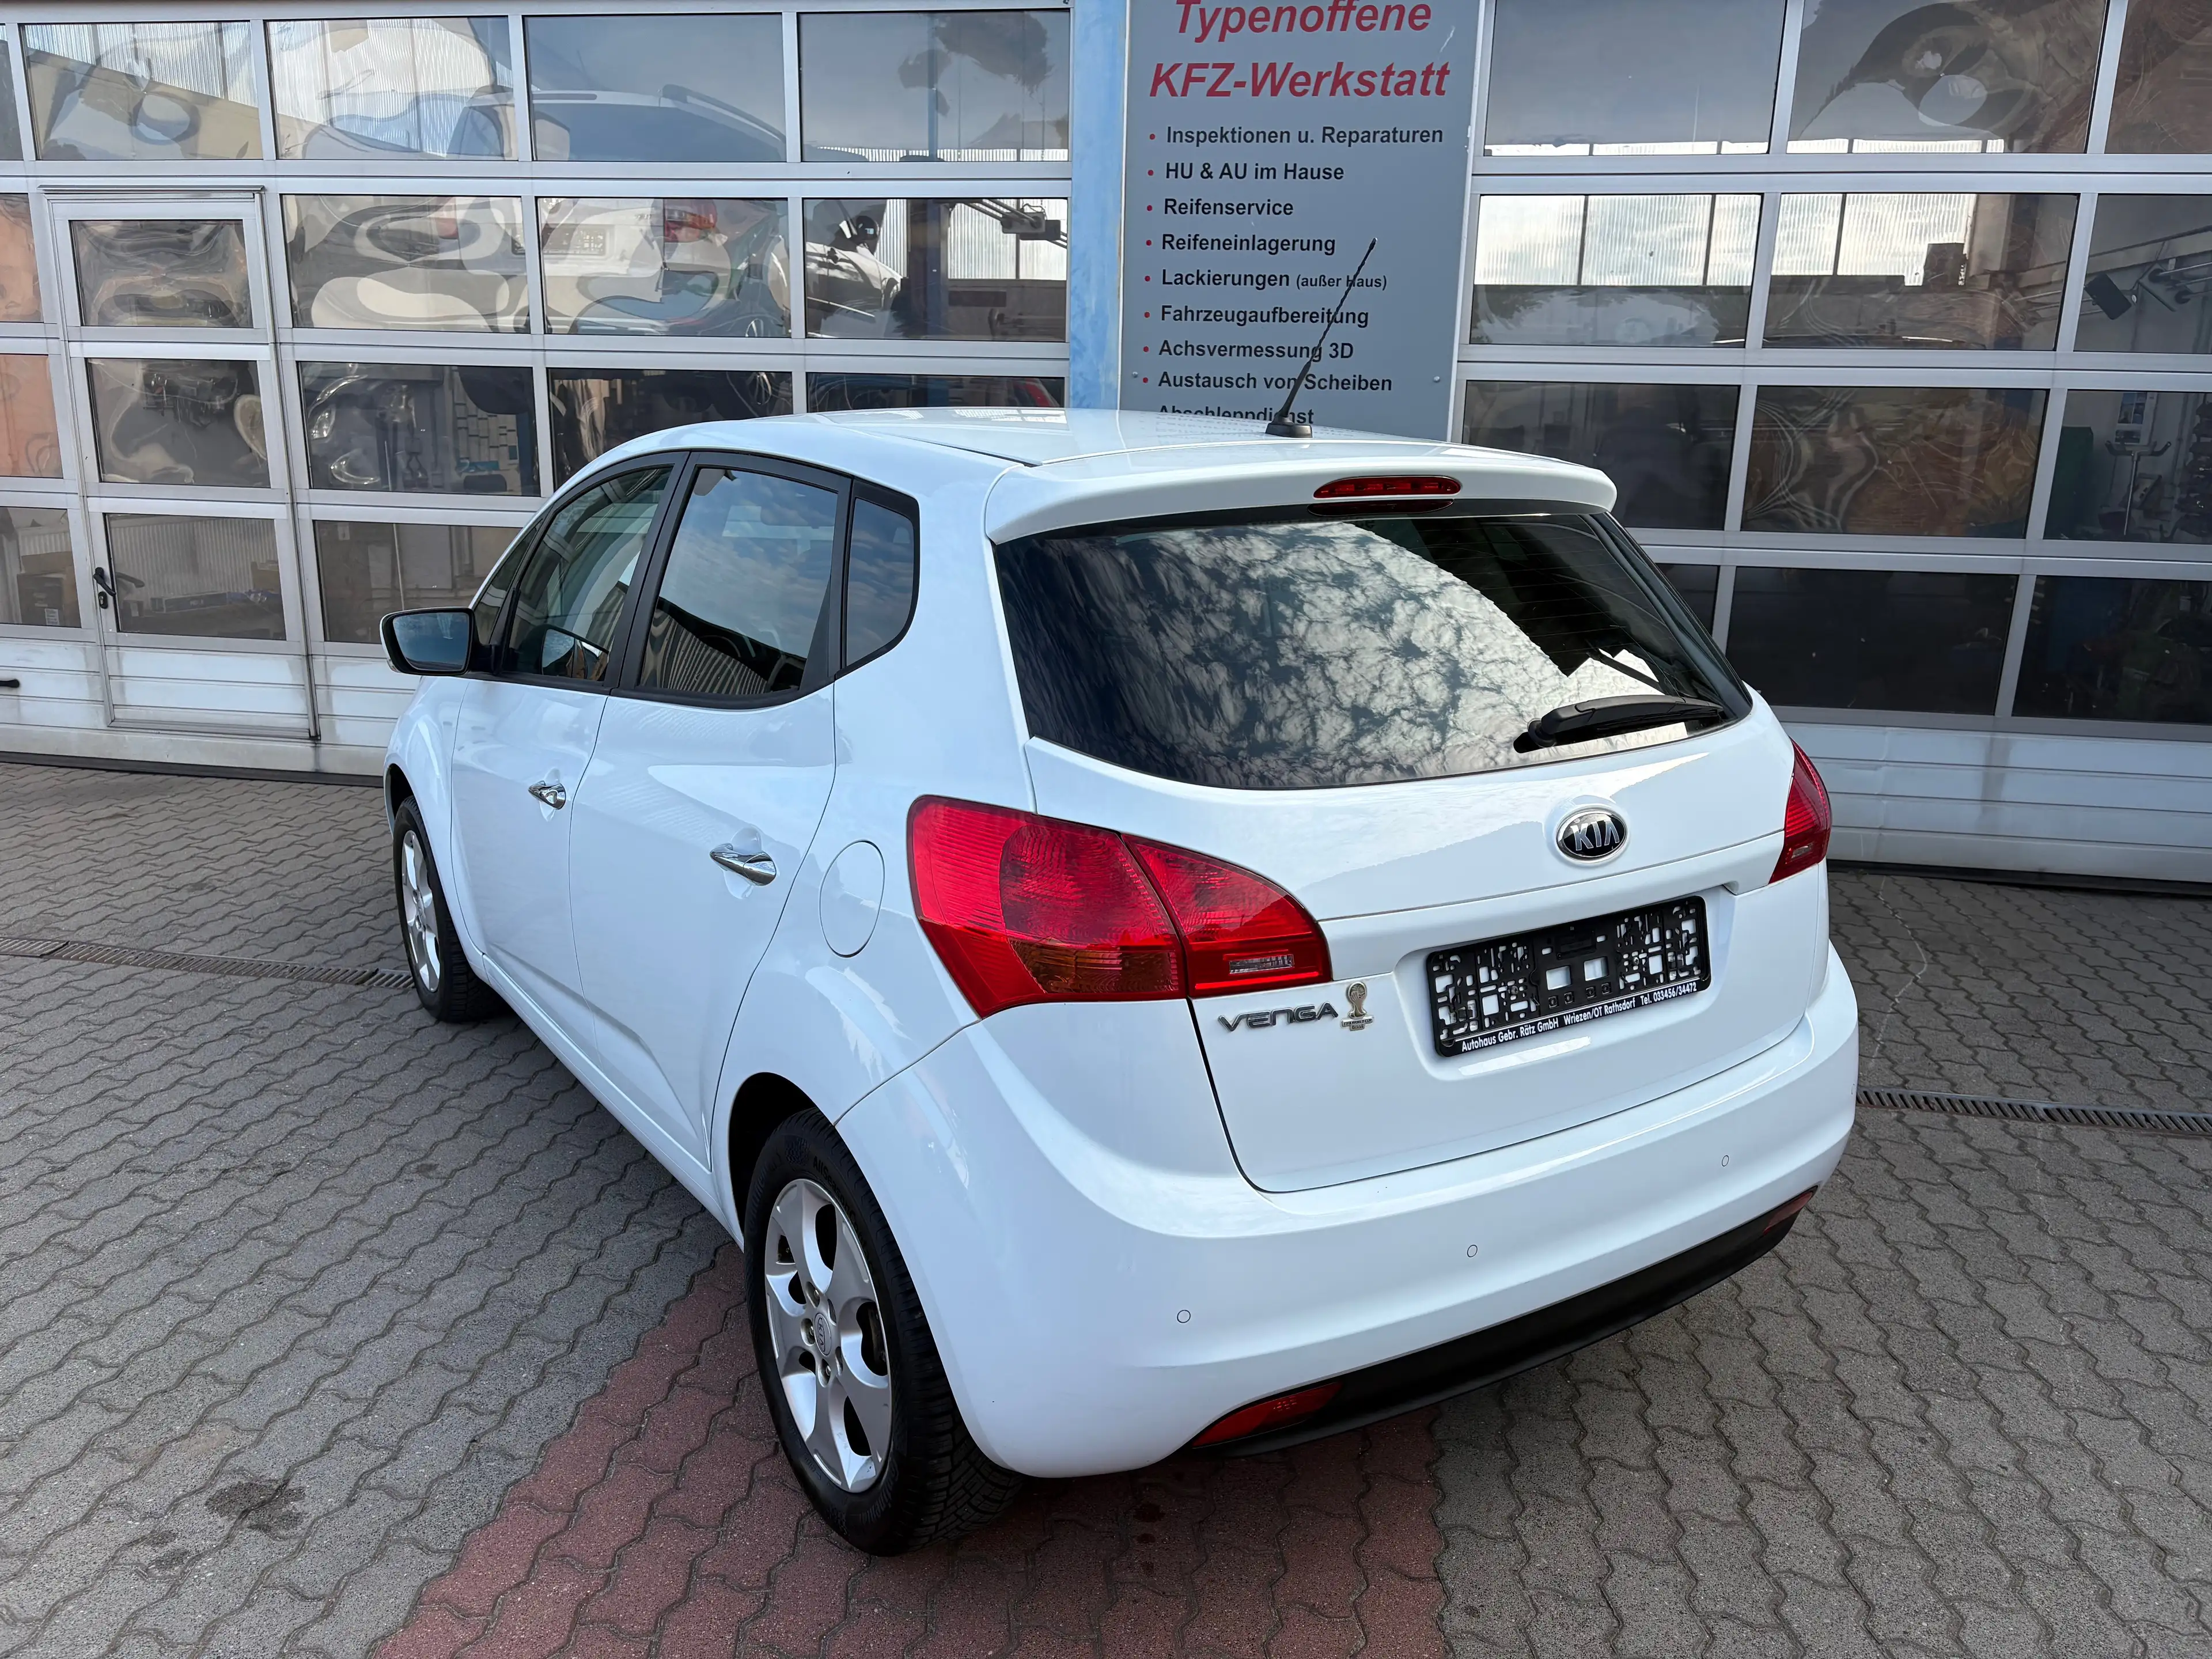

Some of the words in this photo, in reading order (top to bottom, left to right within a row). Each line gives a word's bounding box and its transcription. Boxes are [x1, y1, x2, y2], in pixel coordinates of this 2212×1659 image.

[1176, 0, 1431, 43] Typenoffene
[1150, 62, 1450, 97] KFZ-Werkstatt
[1166, 126, 1291, 148] Inspektionen
[1297, 130, 1315, 144] u.
[1321, 126, 1444, 147] Reparaturen
[1165, 161, 1194, 180] HU
[1199, 162, 1214, 180] &
[1218, 162, 1248, 180] AU
[1254, 162, 1277, 180] im
[1283, 162, 1345, 181] Hause
[1164, 198, 1294, 216] Reifenservice
[1161, 233, 1336, 256] Reifeneinlagerung
[1161, 268, 1290, 290] Lackierungen
[1296, 274, 1342, 290] (außer
[1346, 275, 1387, 291] Haus)
[1161, 304, 1369, 328] Fahrzeugaufbereitung
[1158, 339, 1323, 362] Achsvermessung
[1328, 342, 1354, 359] 3D
[1157, 371, 1257, 389] Austausch
[1303, 373, 1393, 391] Scheiben
[1570, 819, 1620, 851] KIA
[1217, 1000, 1339, 1032] VENGA
[1461, 1035, 1497, 1052] Autohaus
[1498, 1029, 1518, 1043] Gebr.
[1520, 1024, 1536, 1037] Rätz
[1537, 1020, 1559, 1033] GmbH
[1563, 1005, 1603, 1026] Wriezen/OT
[1604, 997, 1636, 1016] Rathsdorf
[1640, 993, 1653, 1006] Tel.
[1653, 981, 1698, 1002] 033456/34472
